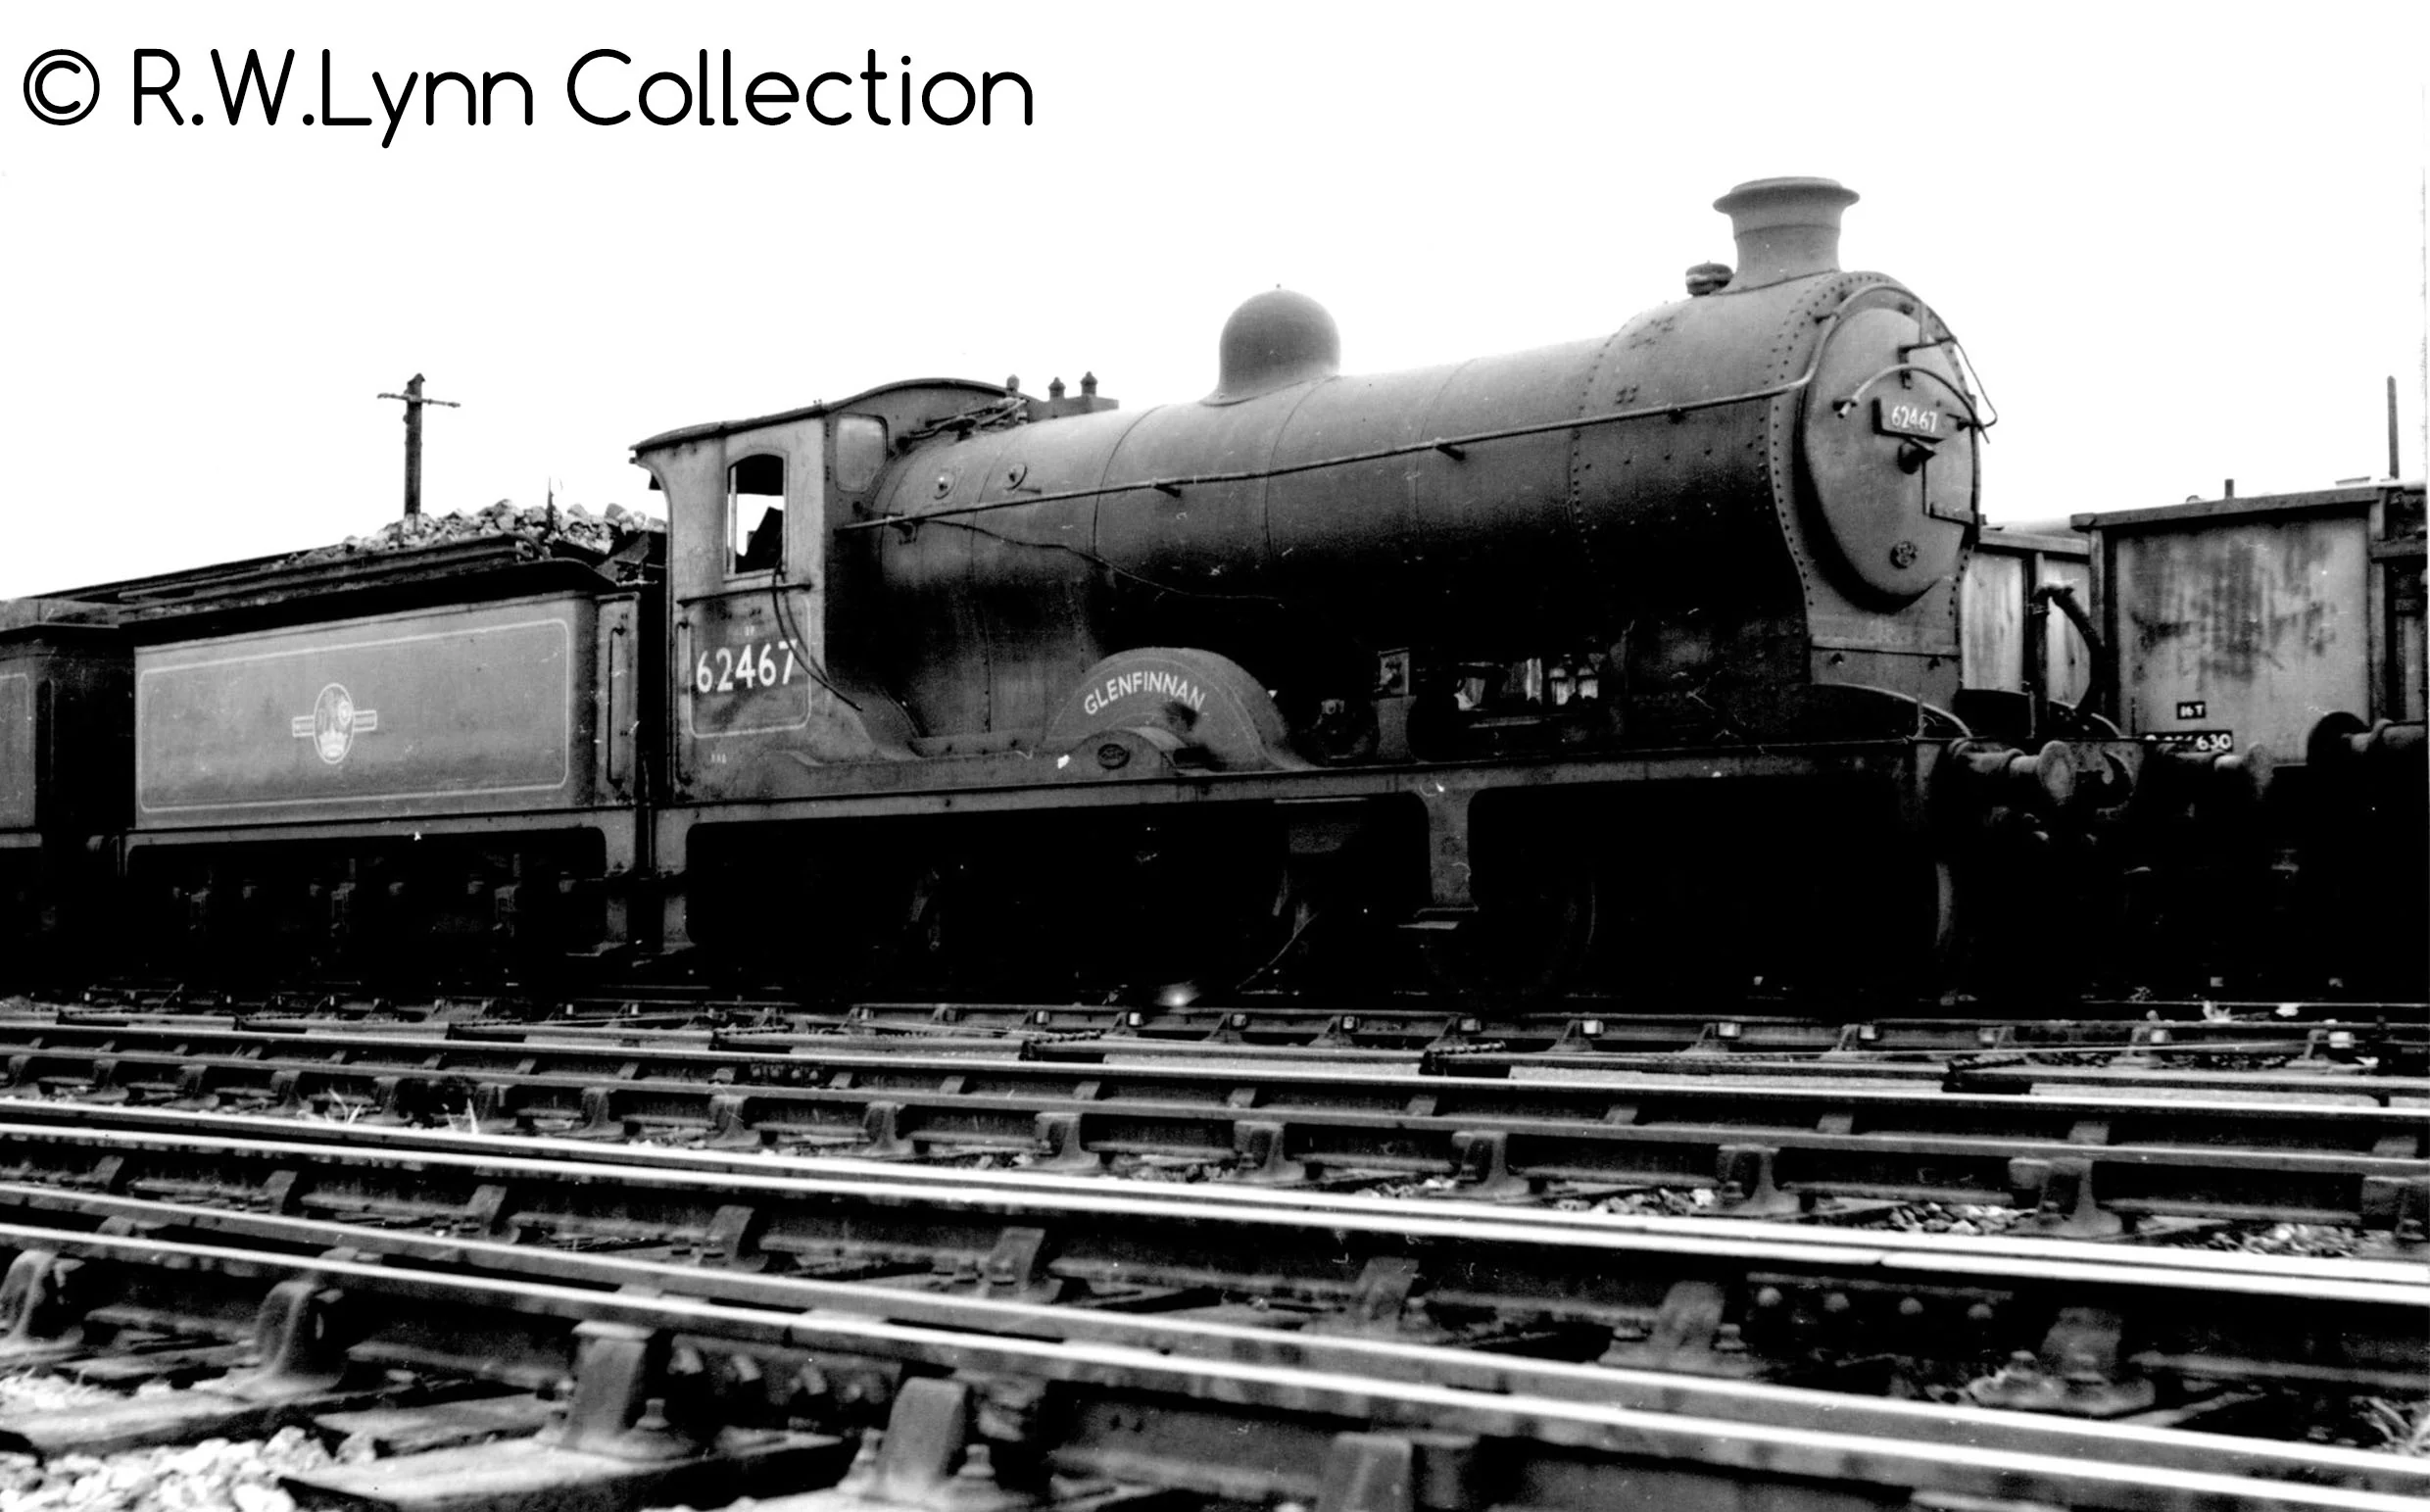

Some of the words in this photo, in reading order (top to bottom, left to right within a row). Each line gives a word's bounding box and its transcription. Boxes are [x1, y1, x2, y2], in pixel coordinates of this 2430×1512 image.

[1891, 406, 1938, 433] 62467
[697, 639, 798, 693] 62467
[1084, 671, 1205, 714] GLENFINNAN
